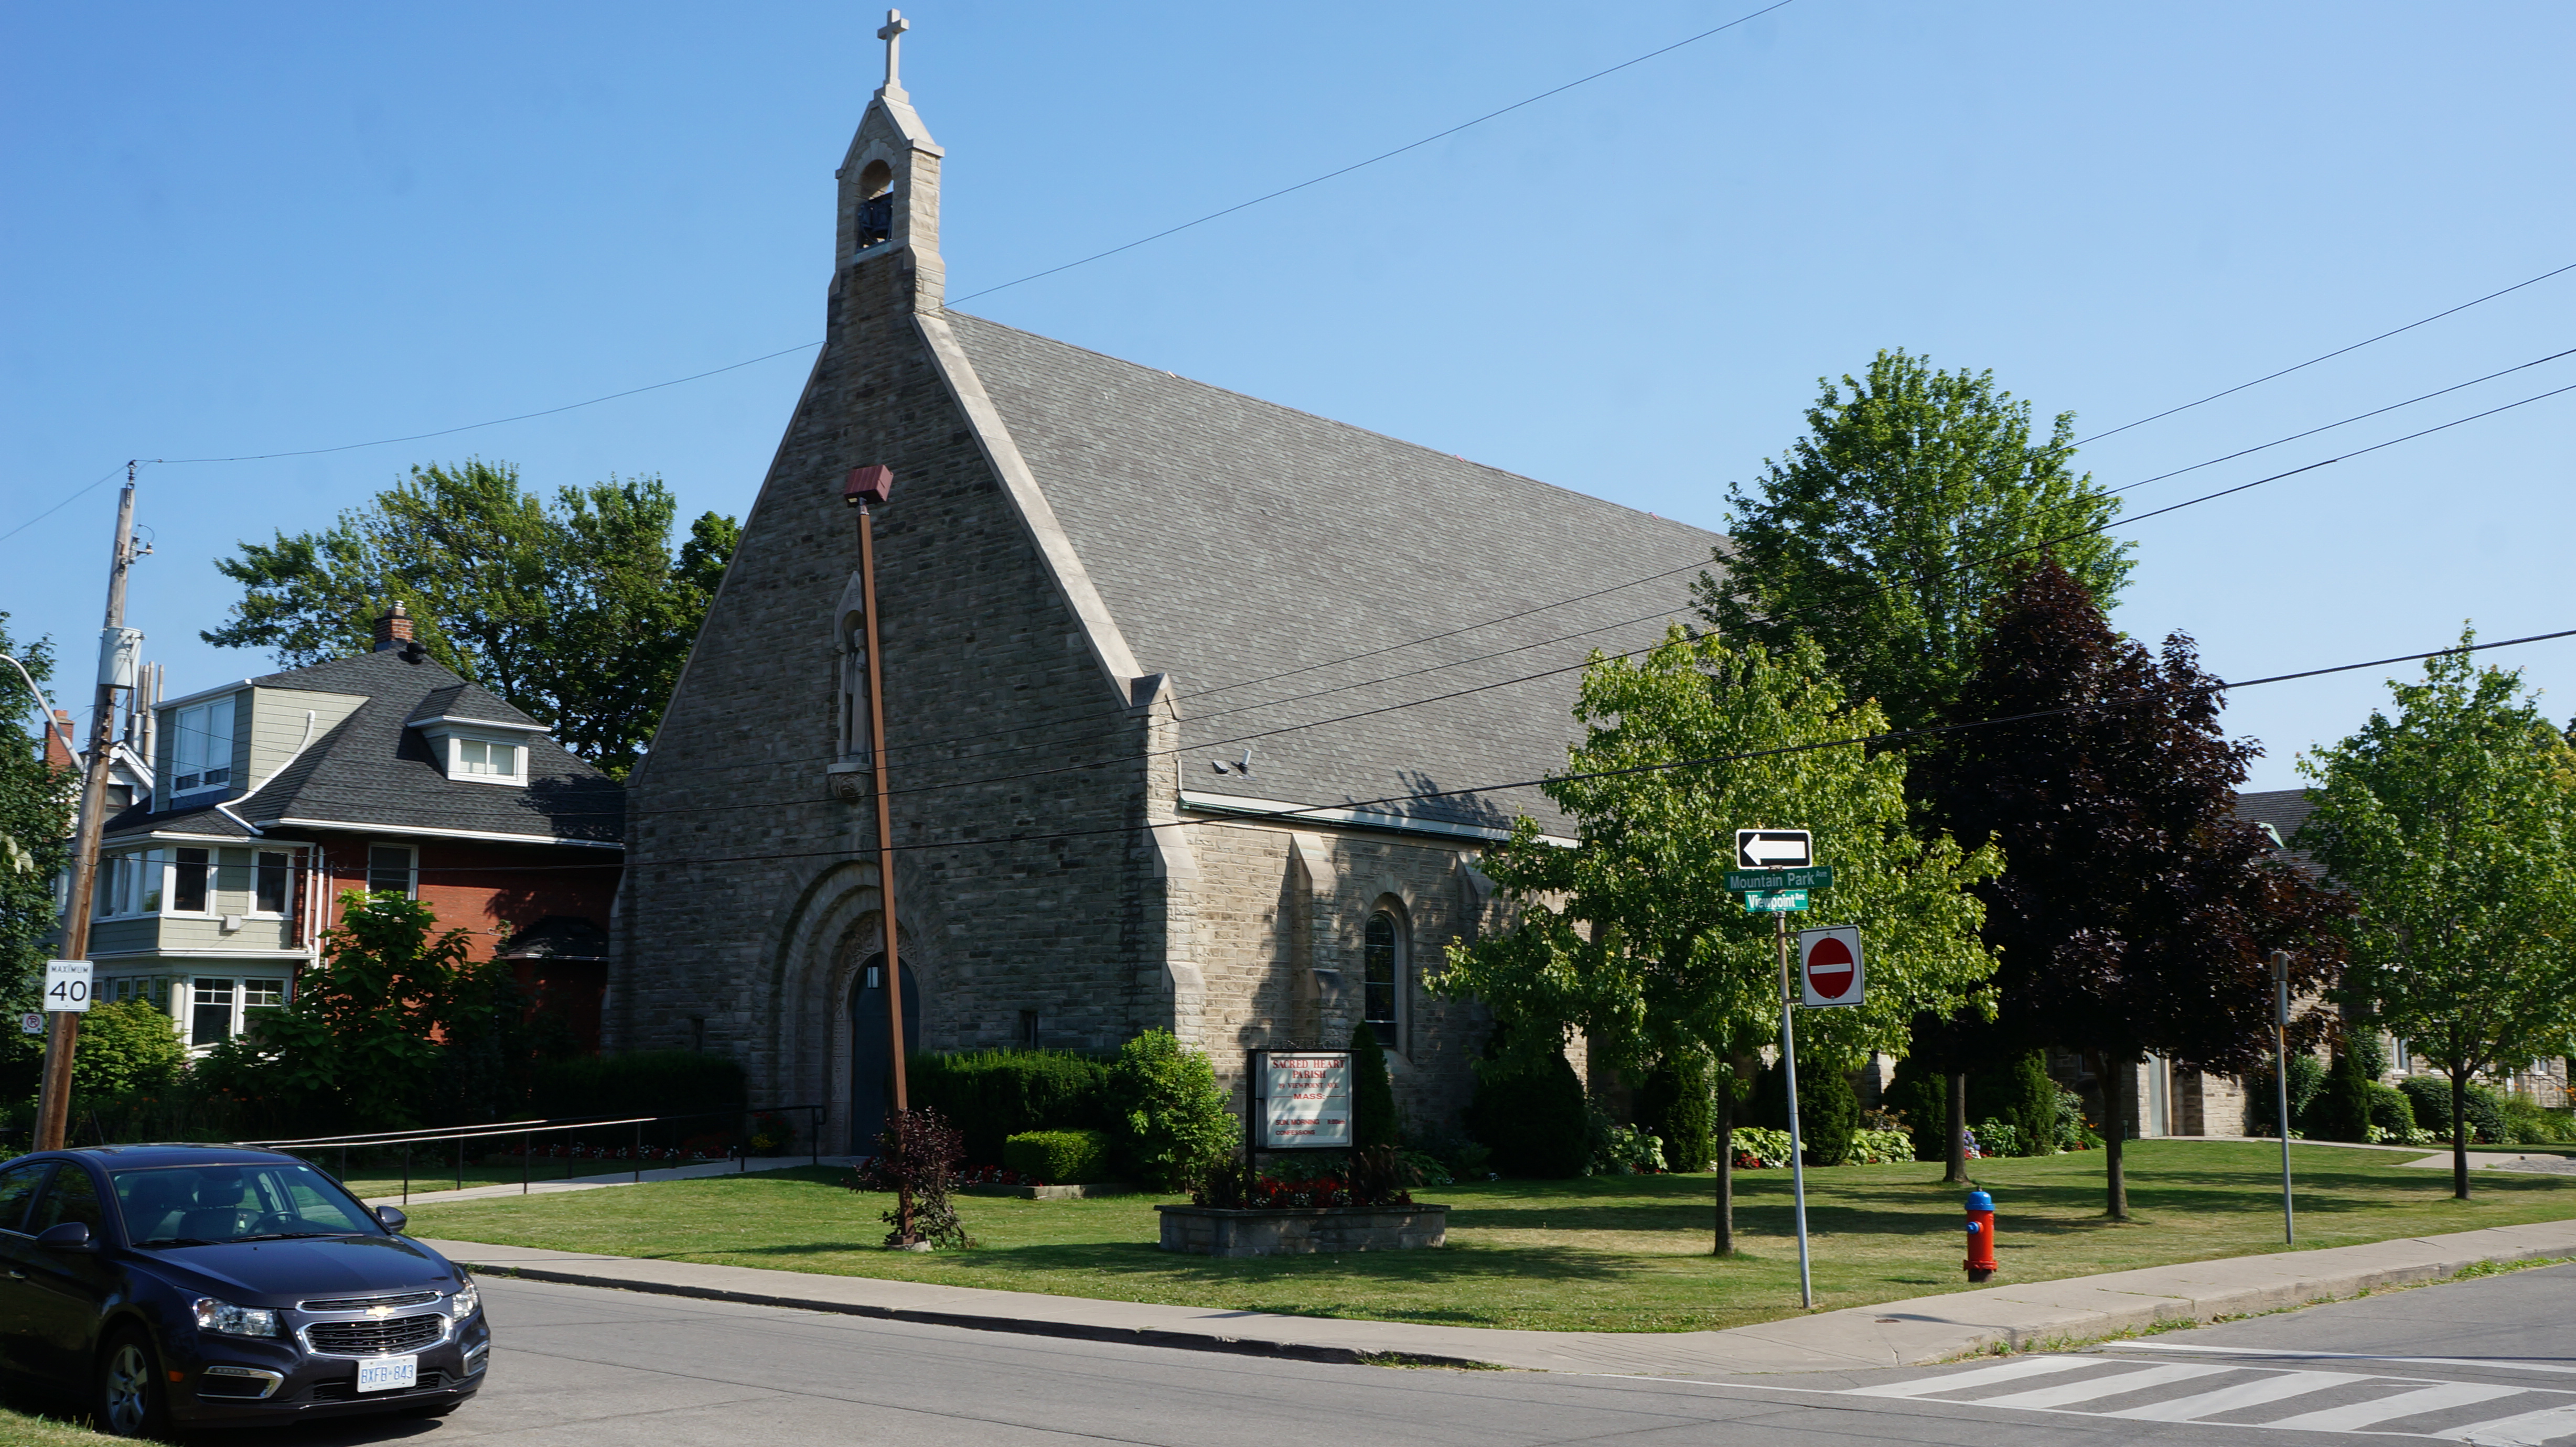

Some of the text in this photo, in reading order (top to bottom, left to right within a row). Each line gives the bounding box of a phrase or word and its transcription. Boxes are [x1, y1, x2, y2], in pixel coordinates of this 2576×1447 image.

[1730, 870, 1828, 889] Mountain Park Ave
[1747, 894, 1796, 910] Viewpoint
[49, 980, 87, 1002] 40
[1273, 1060, 1345, 1068] SACRED HEART
[1292, 1070, 1326, 1078] PARISH
